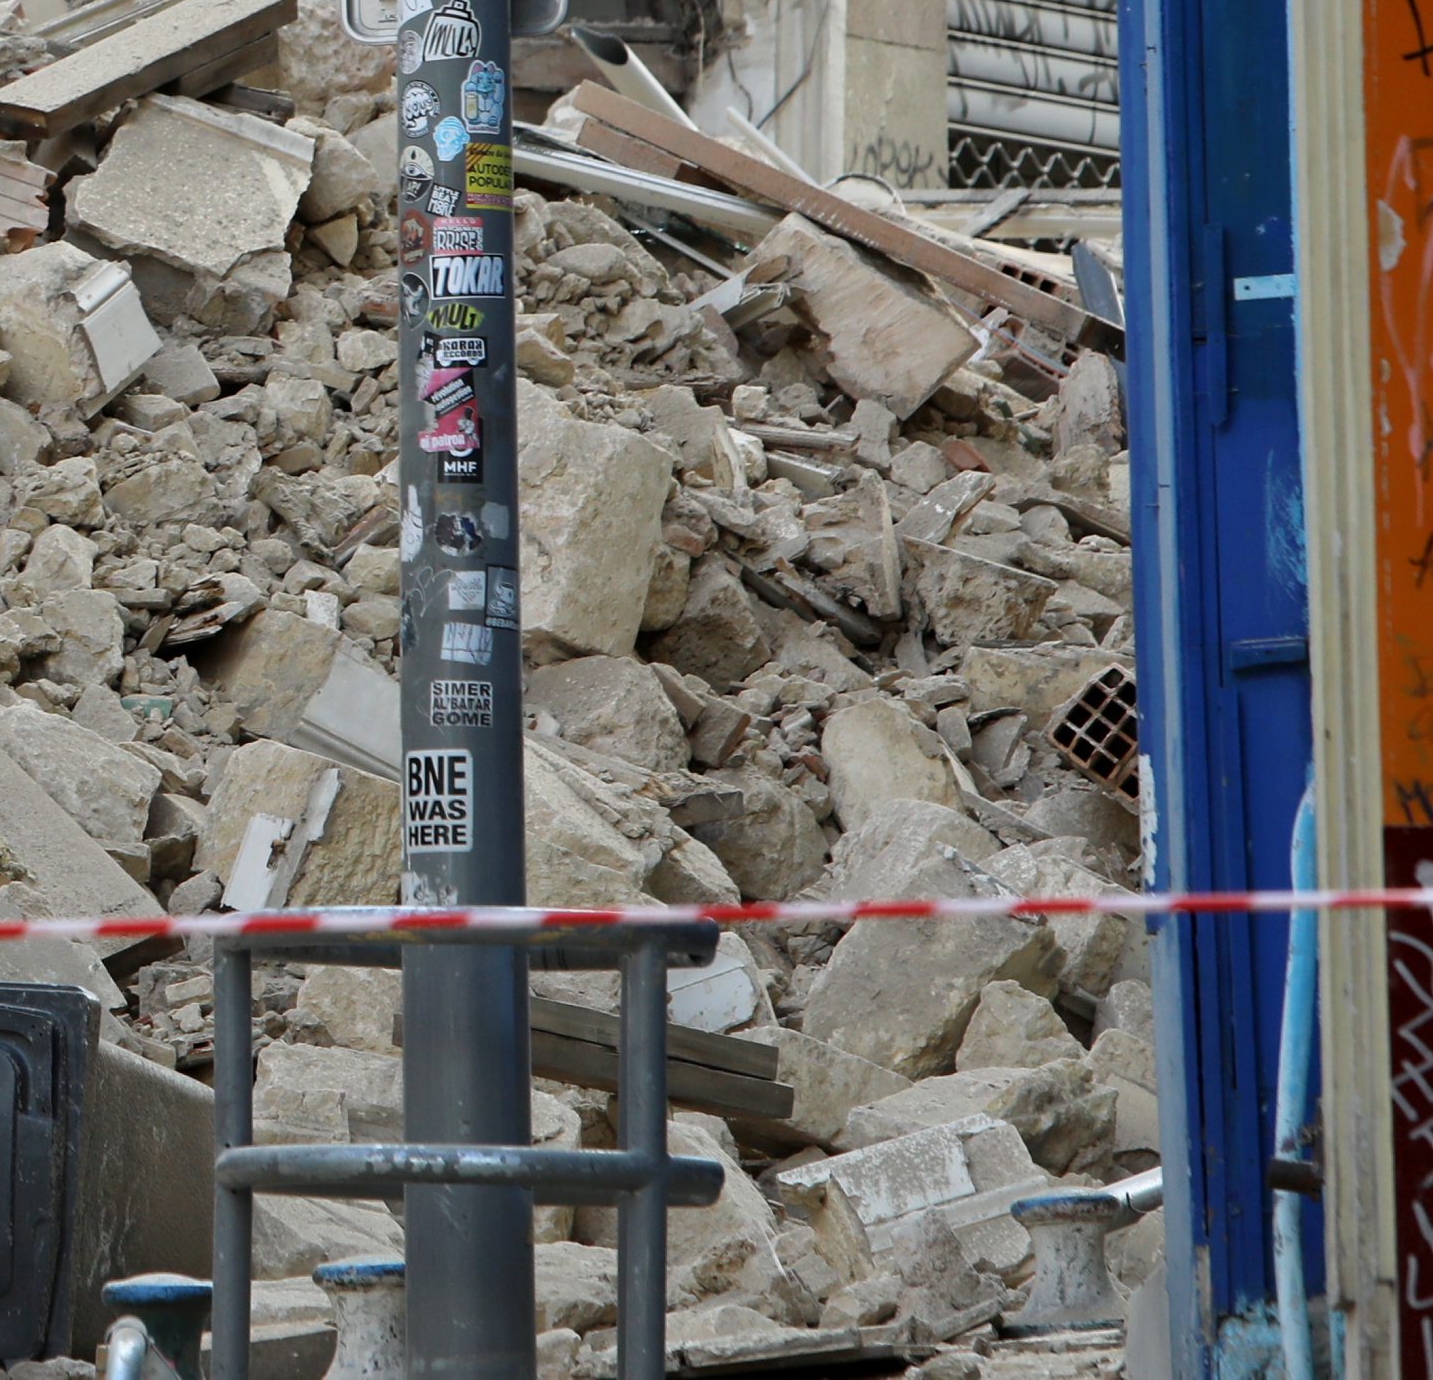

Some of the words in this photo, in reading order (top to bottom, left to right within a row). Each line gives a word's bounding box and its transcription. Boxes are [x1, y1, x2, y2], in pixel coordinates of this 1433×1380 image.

[444, 461, 477, 474] MHF
[408, 756, 467, 796] BNE
[409, 800, 467, 821] WAS
[408, 824, 467, 846] HERE
